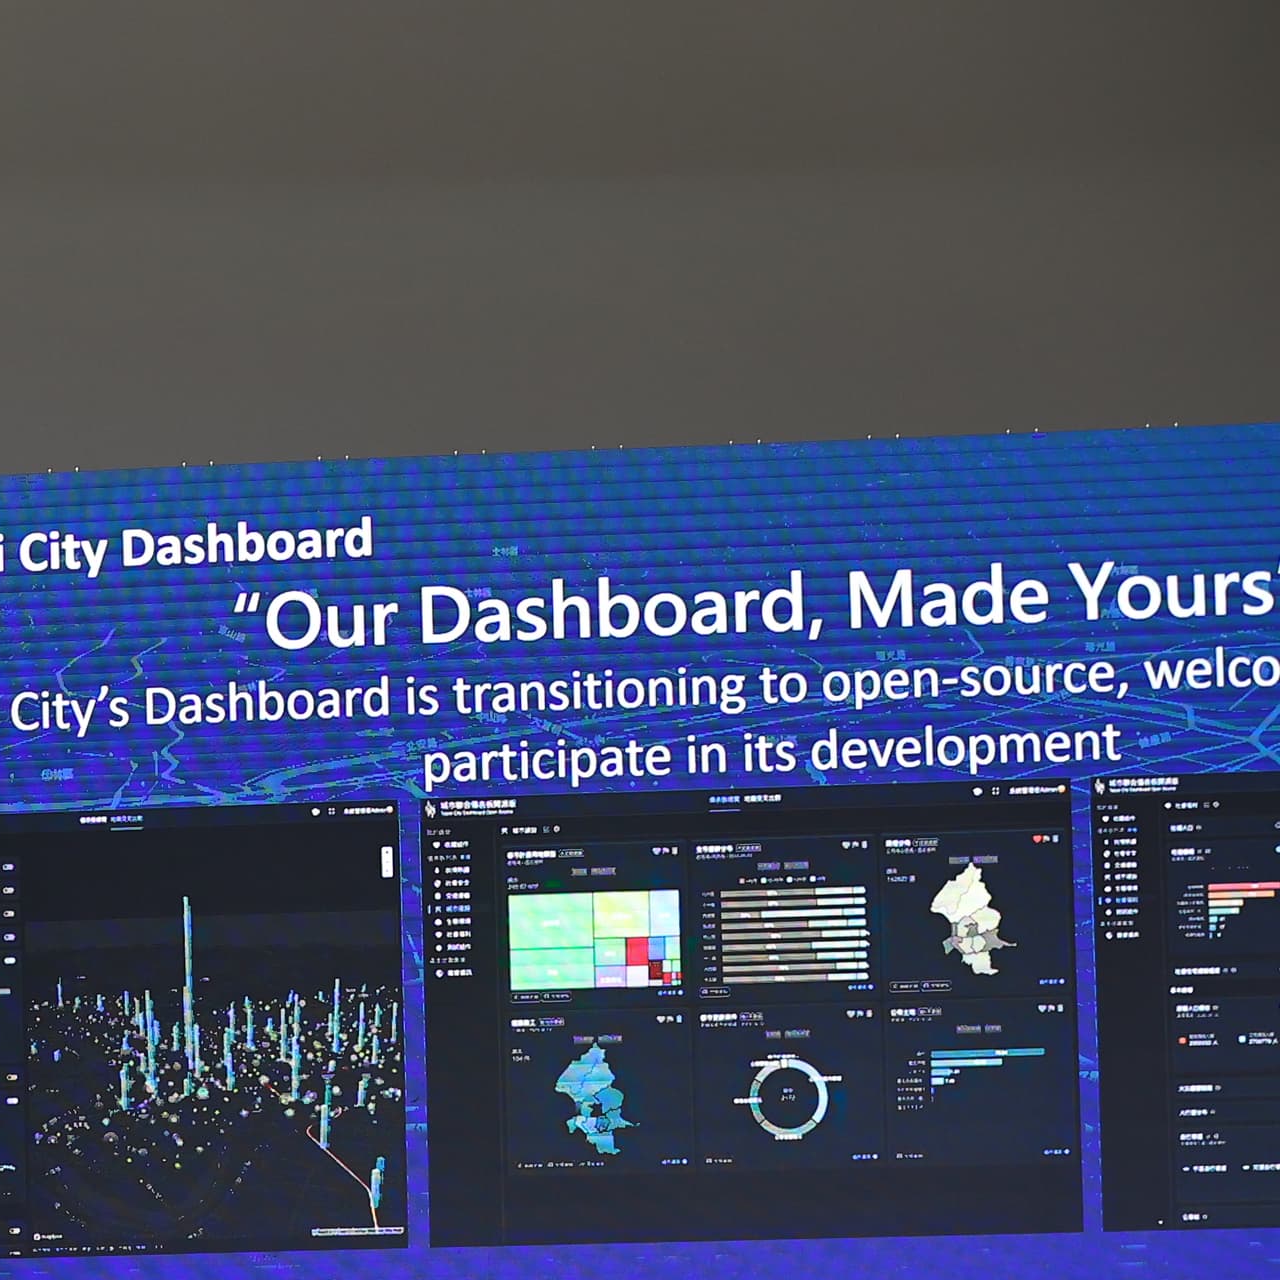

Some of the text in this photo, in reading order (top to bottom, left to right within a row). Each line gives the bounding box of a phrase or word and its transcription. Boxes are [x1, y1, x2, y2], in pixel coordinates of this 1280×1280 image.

[19, 530, 108, 579] City
[122, 515, 381, 567] Dashboard
[421, 570, 823, 644] Dashboard,
[849, 562, 1049, 629] Made
[1067, 558, 1280, 621] Yours
[145, 675, 390, 725] Dashboard
[406, 675, 440, 716] is
[452, 666, 747, 715] transitioning
[758, 667, 808, 704] to
[822, 661, 1129, 710] open-source,
[424, 723, 1122, 793] participate in its development
